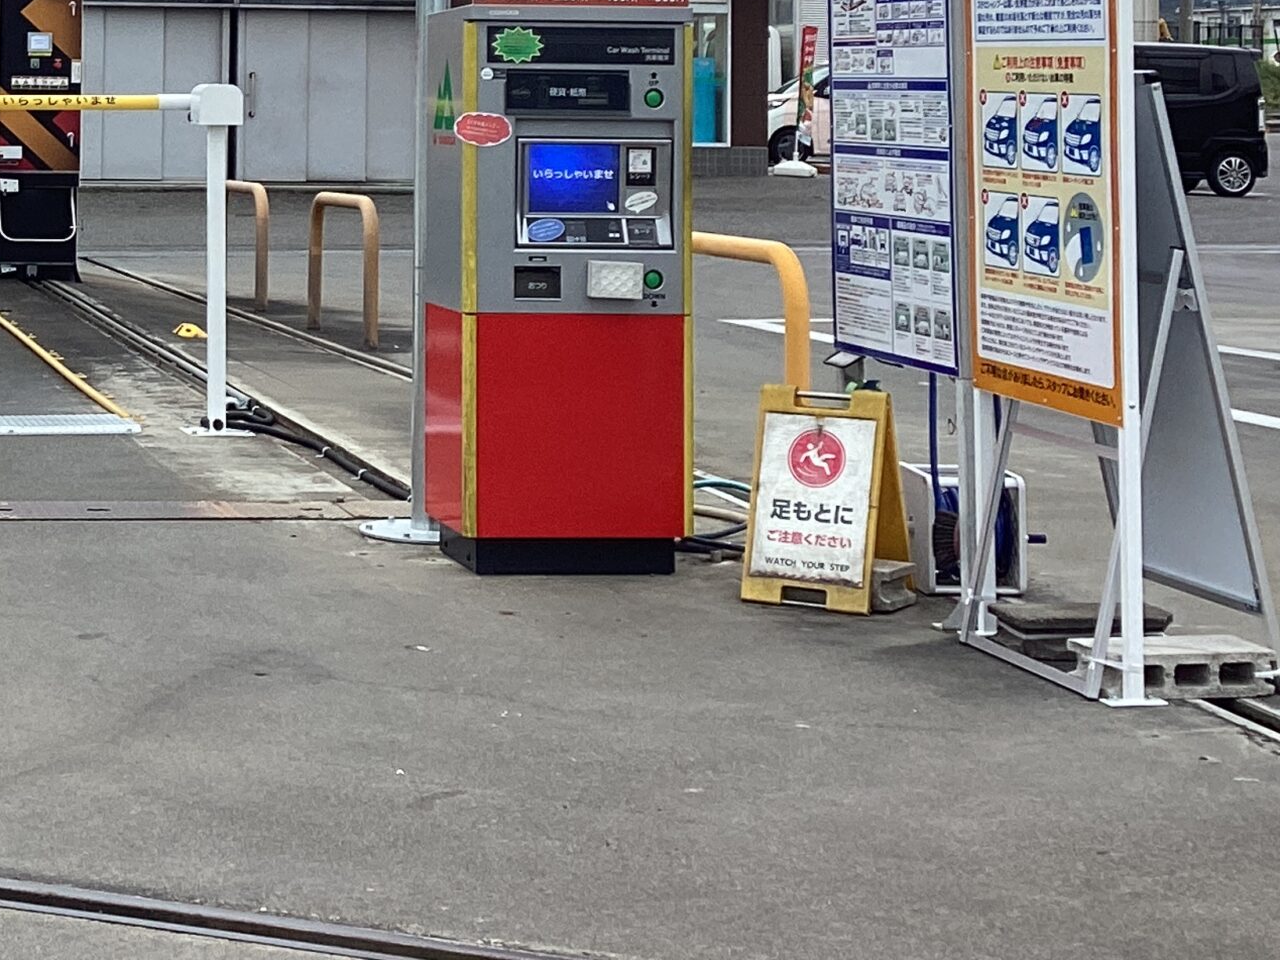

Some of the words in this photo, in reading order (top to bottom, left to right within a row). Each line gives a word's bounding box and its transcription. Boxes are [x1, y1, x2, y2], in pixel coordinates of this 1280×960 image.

[607, 46, 619, 54] Car
[621, 46, 640, 54] Wash
[641, 46, 670, 54] Terminal
[2, 96, 117, 106] いらっしゃいませ
[532, 169, 615, 180] いらっしゃいませ
[769, 498, 855, 525] 足もとに
[766, 529, 853, 549] ご注意ください
[801, 560, 825, 570] YOUR
[829, 563, 851, 573] STEP
